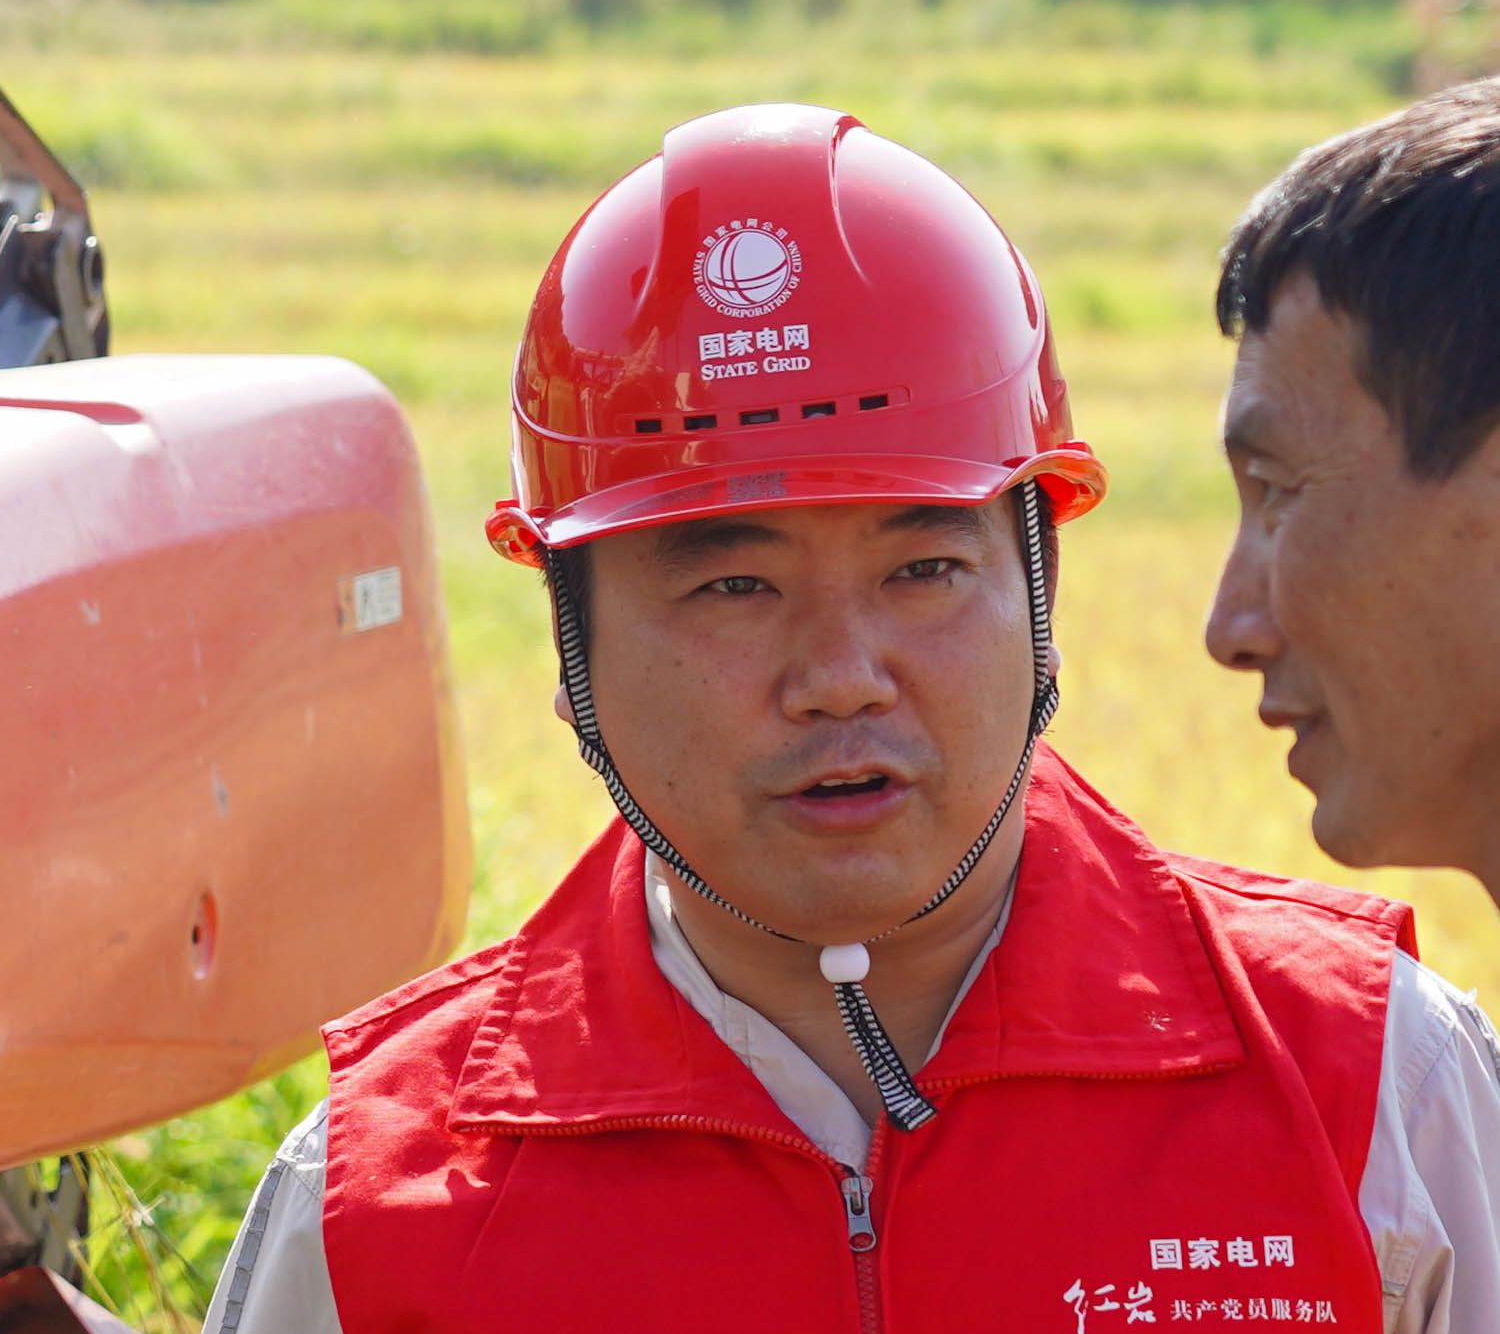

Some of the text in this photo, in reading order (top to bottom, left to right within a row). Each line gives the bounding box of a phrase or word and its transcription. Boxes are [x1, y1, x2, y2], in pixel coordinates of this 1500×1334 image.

[703, 218, 789, 248] 国家电网公司
[692, 240, 802, 318] STATE GRID CORPORATION OF CHINA
[699, 324, 809, 361] 国家电网
[701, 356, 811, 380] STATE GRID
[1149, 1235, 1295, 1270] 国家电网
[1170, 1298, 1337, 1324] 共产党员服务队
